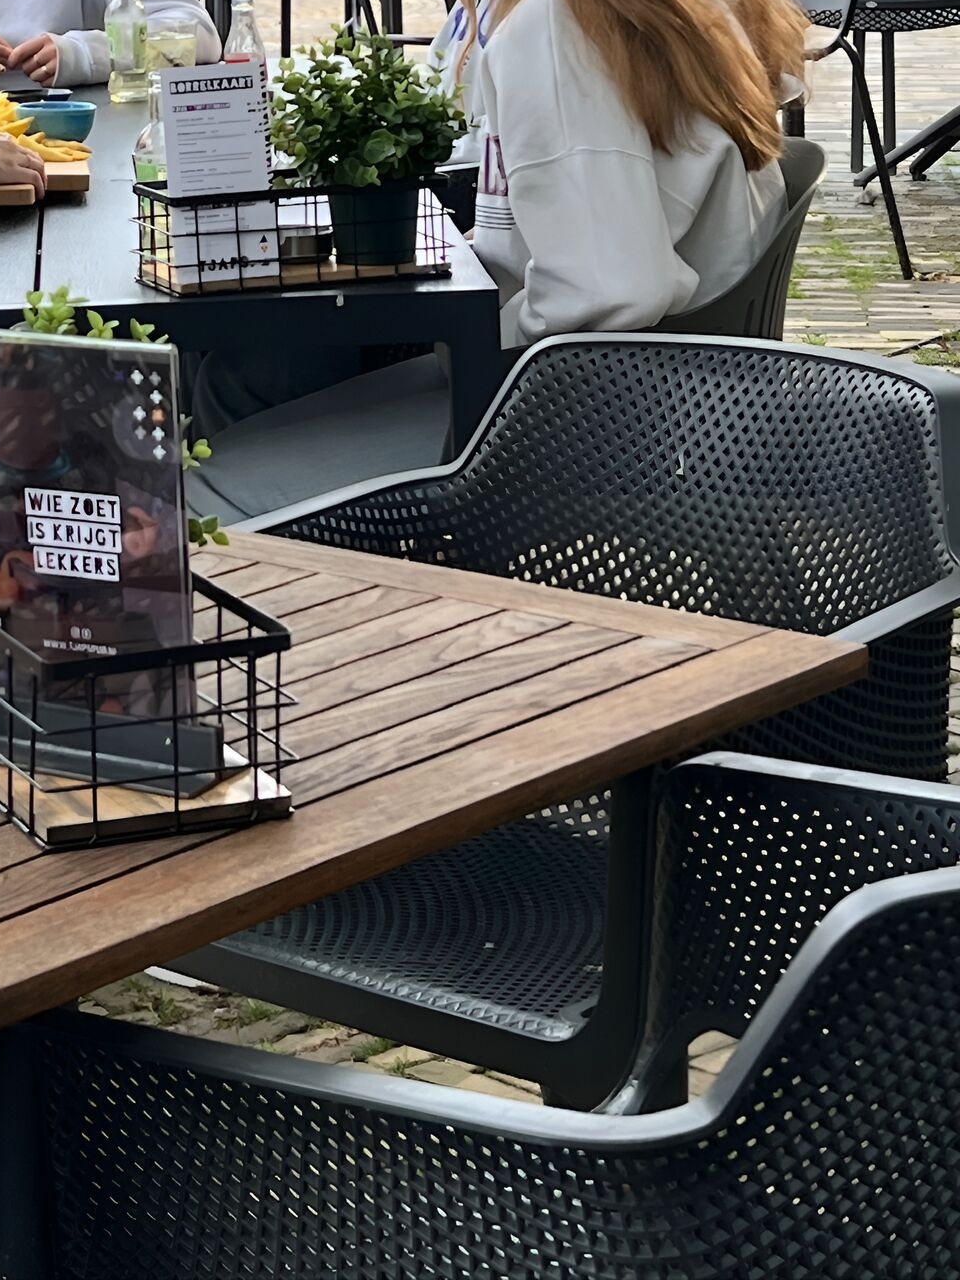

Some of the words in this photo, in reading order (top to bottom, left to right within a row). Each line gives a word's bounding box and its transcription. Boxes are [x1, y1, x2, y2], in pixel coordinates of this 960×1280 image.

[170, 77, 253, 94] BORRELKAART
[28, 492, 62, 513] WIE
[70, 496, 117, 518] ZOET
[30, 521, 45, 539] IS
[53, 523, 120, 548] KRIJGT
[37, 551, 116, 576] LEKKERS
